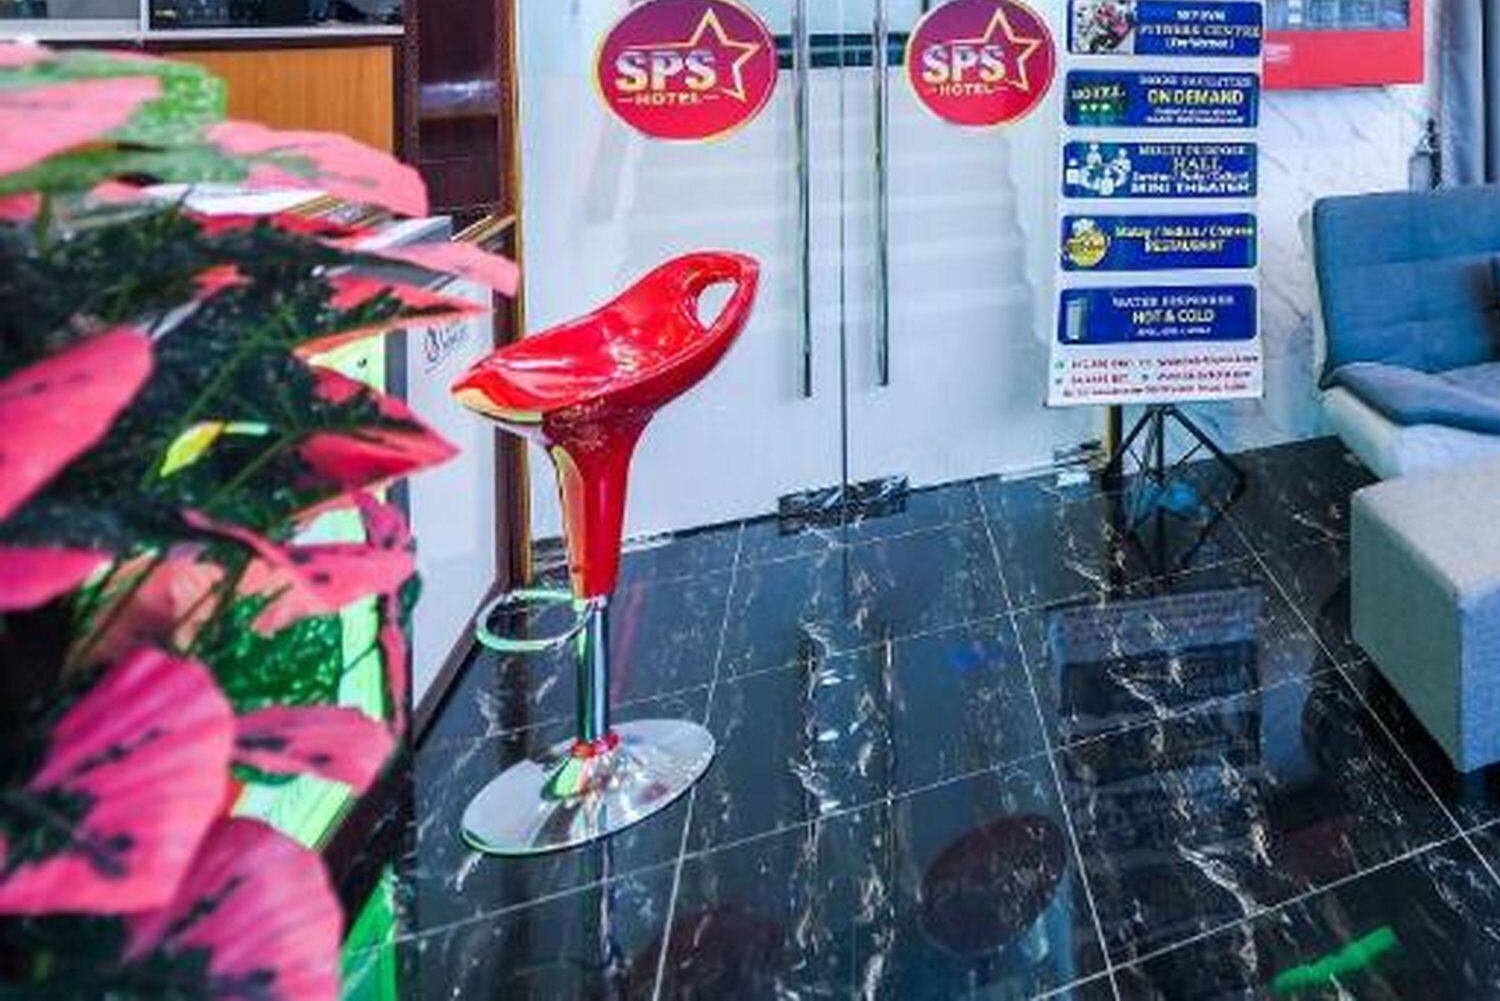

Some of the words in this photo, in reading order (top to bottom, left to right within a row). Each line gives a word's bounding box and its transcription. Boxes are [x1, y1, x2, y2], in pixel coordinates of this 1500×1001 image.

[613, 47, 718, 92] SPS
[920, 42, 1007, 84] SPS
[937, 83, 996, 96] HOTEL
[1147, 89, 1172, 105] ON
[1174, 89, 1244, 105] DEMAND
[635, 91, 702, 105] HOTEL
[1173, 156, 1223, 172] HALL
[1133, 311, 1160, 324] HOT
[1177, 310, 1216, 323] COLD
